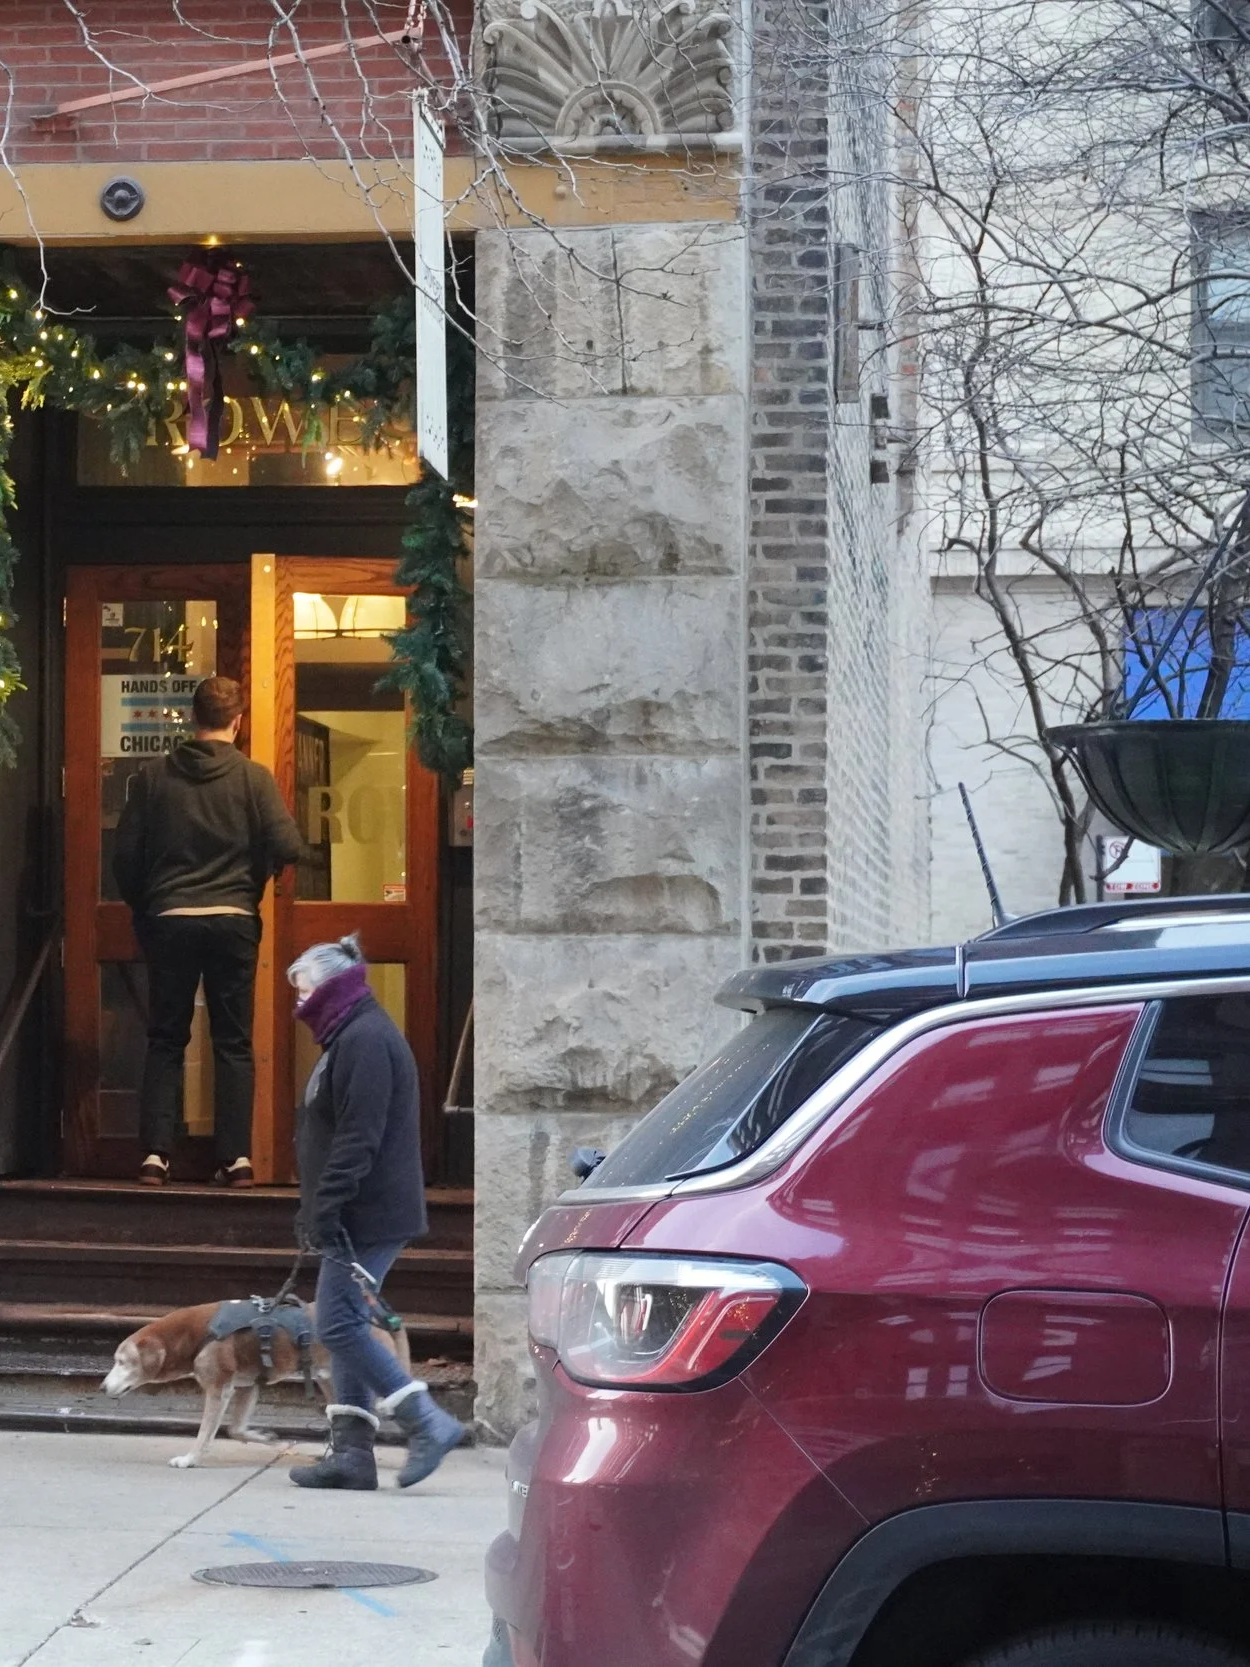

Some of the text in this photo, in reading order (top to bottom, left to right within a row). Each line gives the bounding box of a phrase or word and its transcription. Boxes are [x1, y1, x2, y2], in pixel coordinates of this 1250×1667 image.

[124, 626, 194, 663] 714
[121, 680, 197, 693] HANDS OFF
